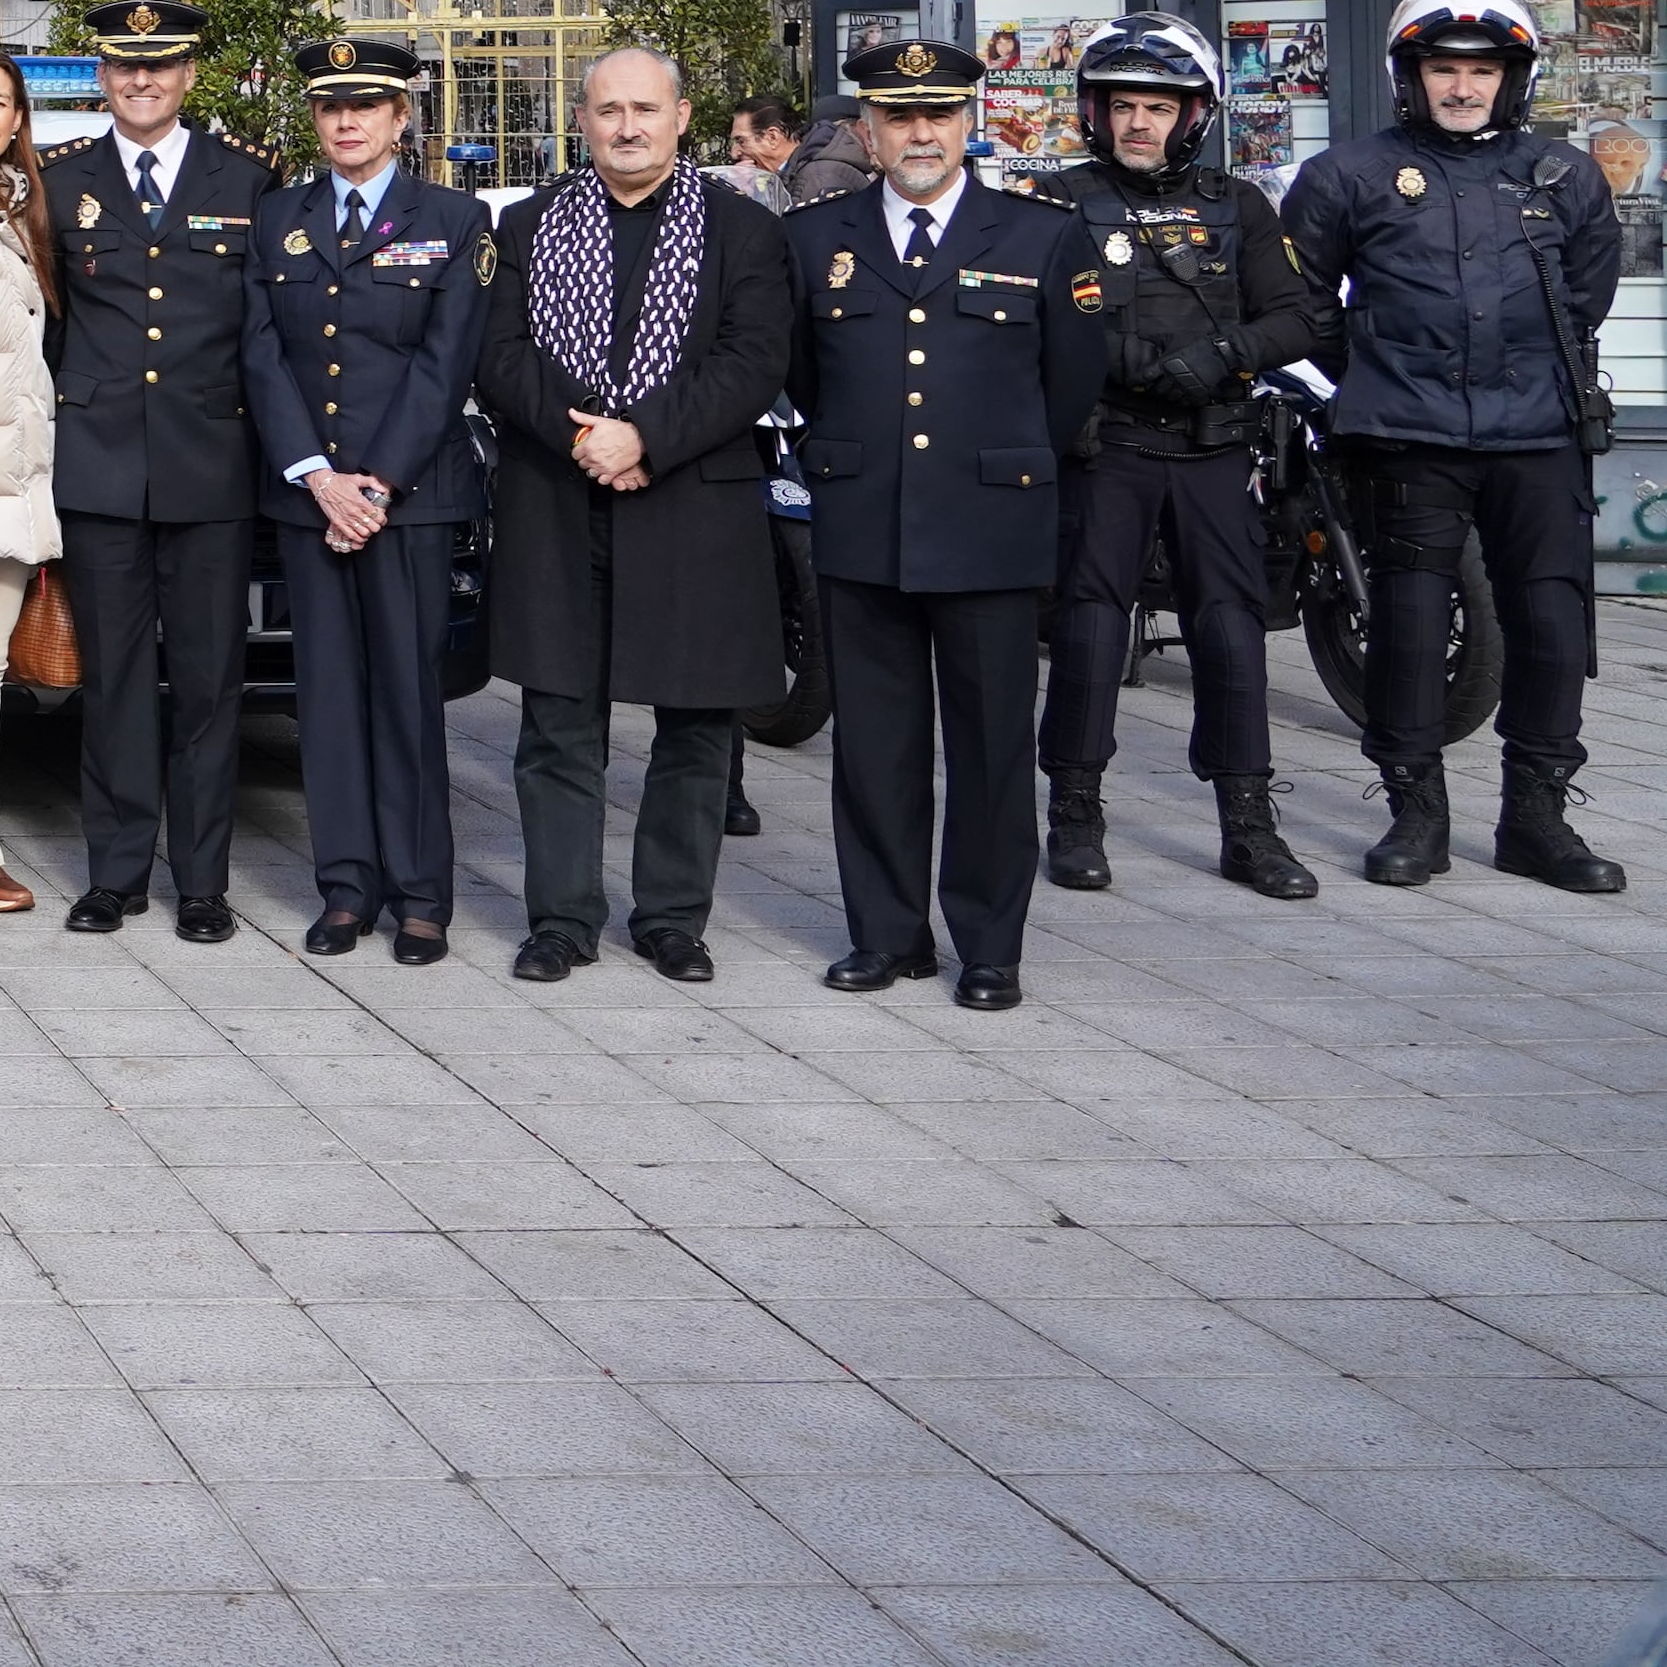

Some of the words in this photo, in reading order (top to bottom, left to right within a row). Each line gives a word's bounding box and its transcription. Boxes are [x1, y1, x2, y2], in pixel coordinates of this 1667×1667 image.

[988, 70, 1007, 78] LAS
[1009, 70, 1054, 78] MEJORES
[1003, 77, 1030, 86] PARA
[986, 89, 1023, 98] SABER
[1009, 159, 1060, 172] COCINA
